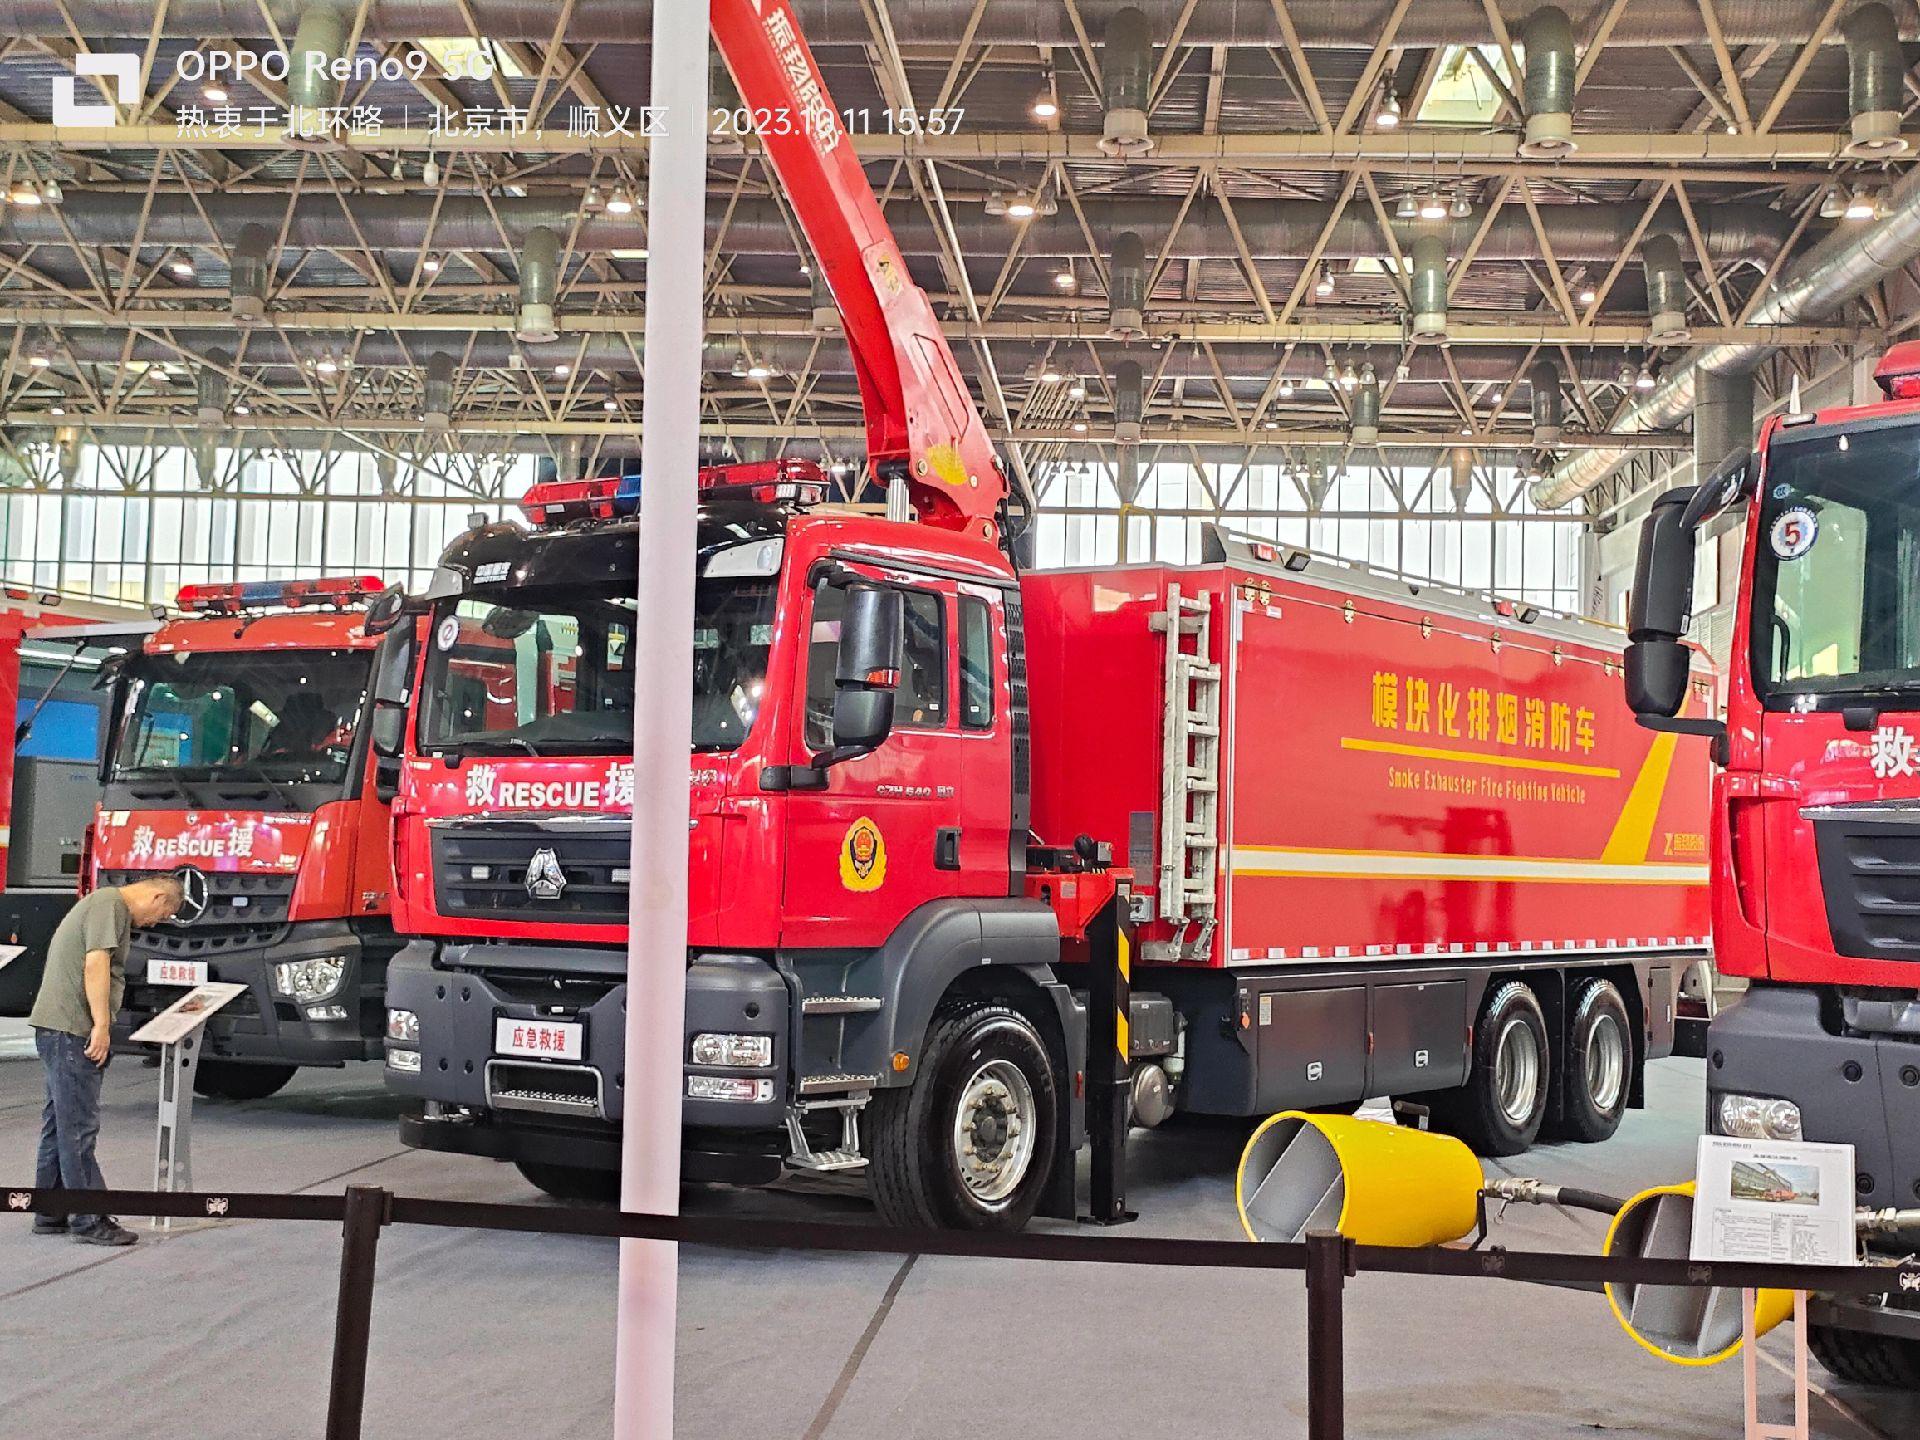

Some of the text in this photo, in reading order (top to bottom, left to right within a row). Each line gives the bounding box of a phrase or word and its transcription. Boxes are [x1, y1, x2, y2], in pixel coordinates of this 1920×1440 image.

[1784, 521, 1801, 547] 5
[1371, 671, 1596, 755] 模块化排烟消防车
[1870, 726, 1915, 778] 救
[466, 764, 498, 807] 救
[499, 781, 600, 808] RESCUE
[1387, 766, 1586, 804] Smoke Exhauster Fire Fighting Vehicle
[132, 825, 254, 858] 救 RESCUE 援
[512, 1026, 566, 1052] 应急救援
